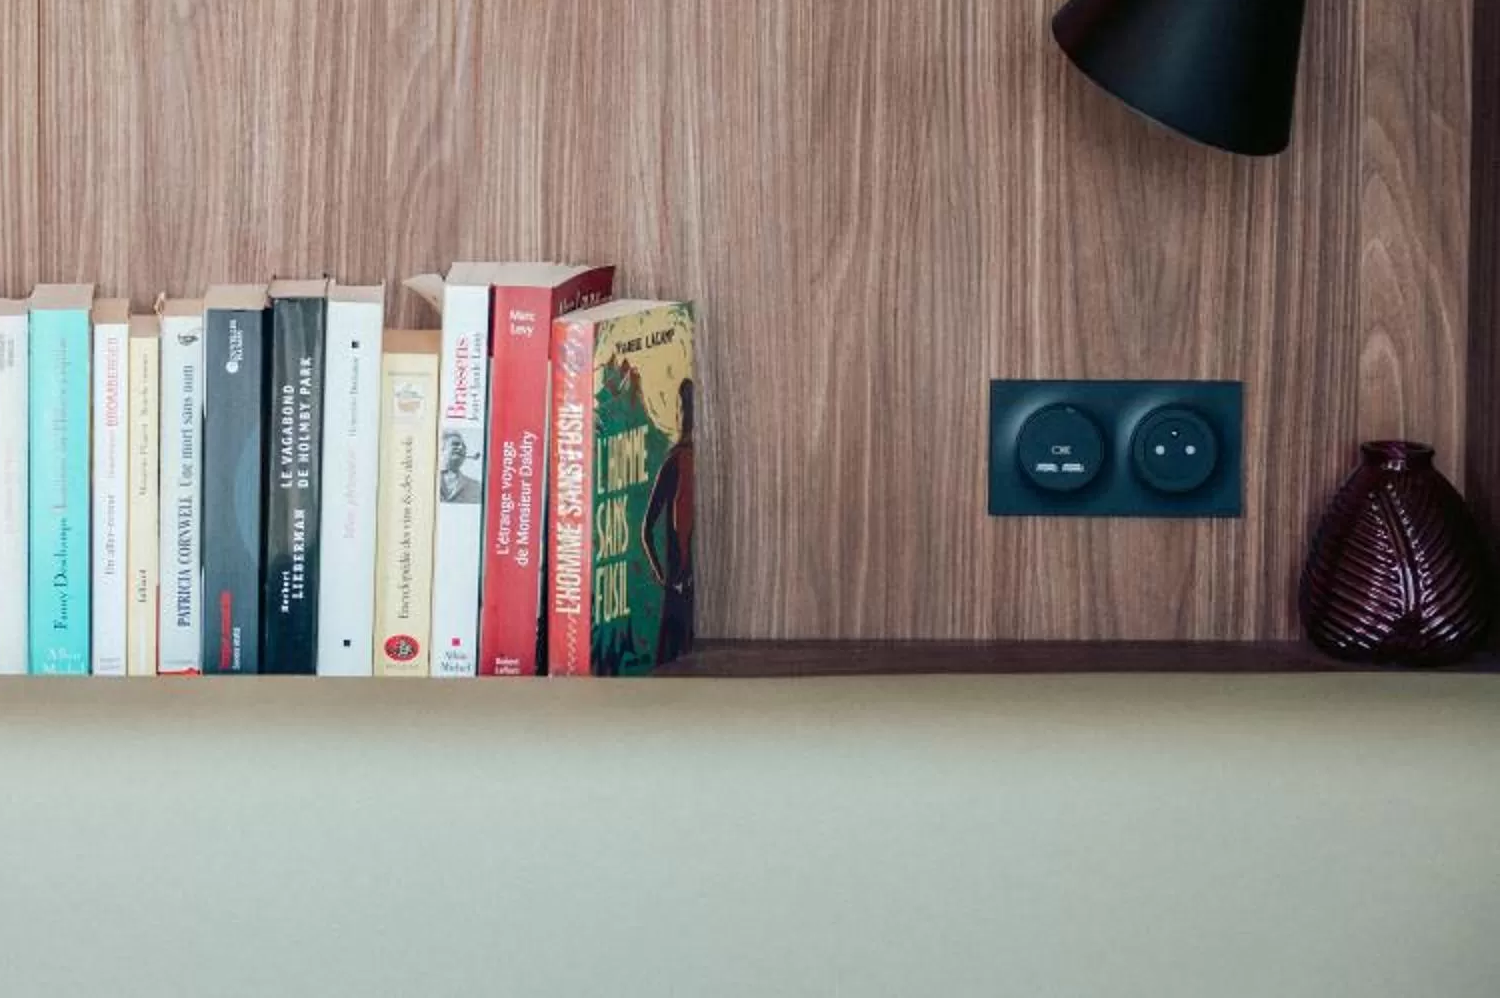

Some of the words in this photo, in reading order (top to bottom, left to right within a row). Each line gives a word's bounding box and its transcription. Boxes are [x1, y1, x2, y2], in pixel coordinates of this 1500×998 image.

[510, 322, 535, 336] Levy
[182, 364, 194, 393] nom
[300, 356, 313, 394] PARK
[446, 333, 468, 420] Brassens
[181, 395, 194, 426] sans
[281, 384, 294, 464] VAGABOND
[298, 402, 312, 463] HOLMBY
[557, 402, 585, 458] FUSIL
[180, 429, 193, 460] mort
[501, 440, 516, 489] voyage
[518, 430, 537, 476] Daldry
[177, 462, 193, 488] Une
[281, 470, 293, 489] LE
[297, 469, 310, 488] DE
[557, 459, 583, 517] SANS
[176, 494, 192, 565] CORNWELL
[496, 493, 513, 555] L'étrange
[515, 480, 532, 545] Monsieur
[596, 494, 629, 561] SANS
[52, 517, 72, 589] Deschamps
[292, 508, 305, 599] LIEBERMAN
[516, 549, 529, 567] de
[556, 521, 582, 614] L'HOMME
[53, 591, 72, 631] Fanny
[177, 568, 193, 627] PATRICIA
[596, 560, 631, 625] FUSIL
